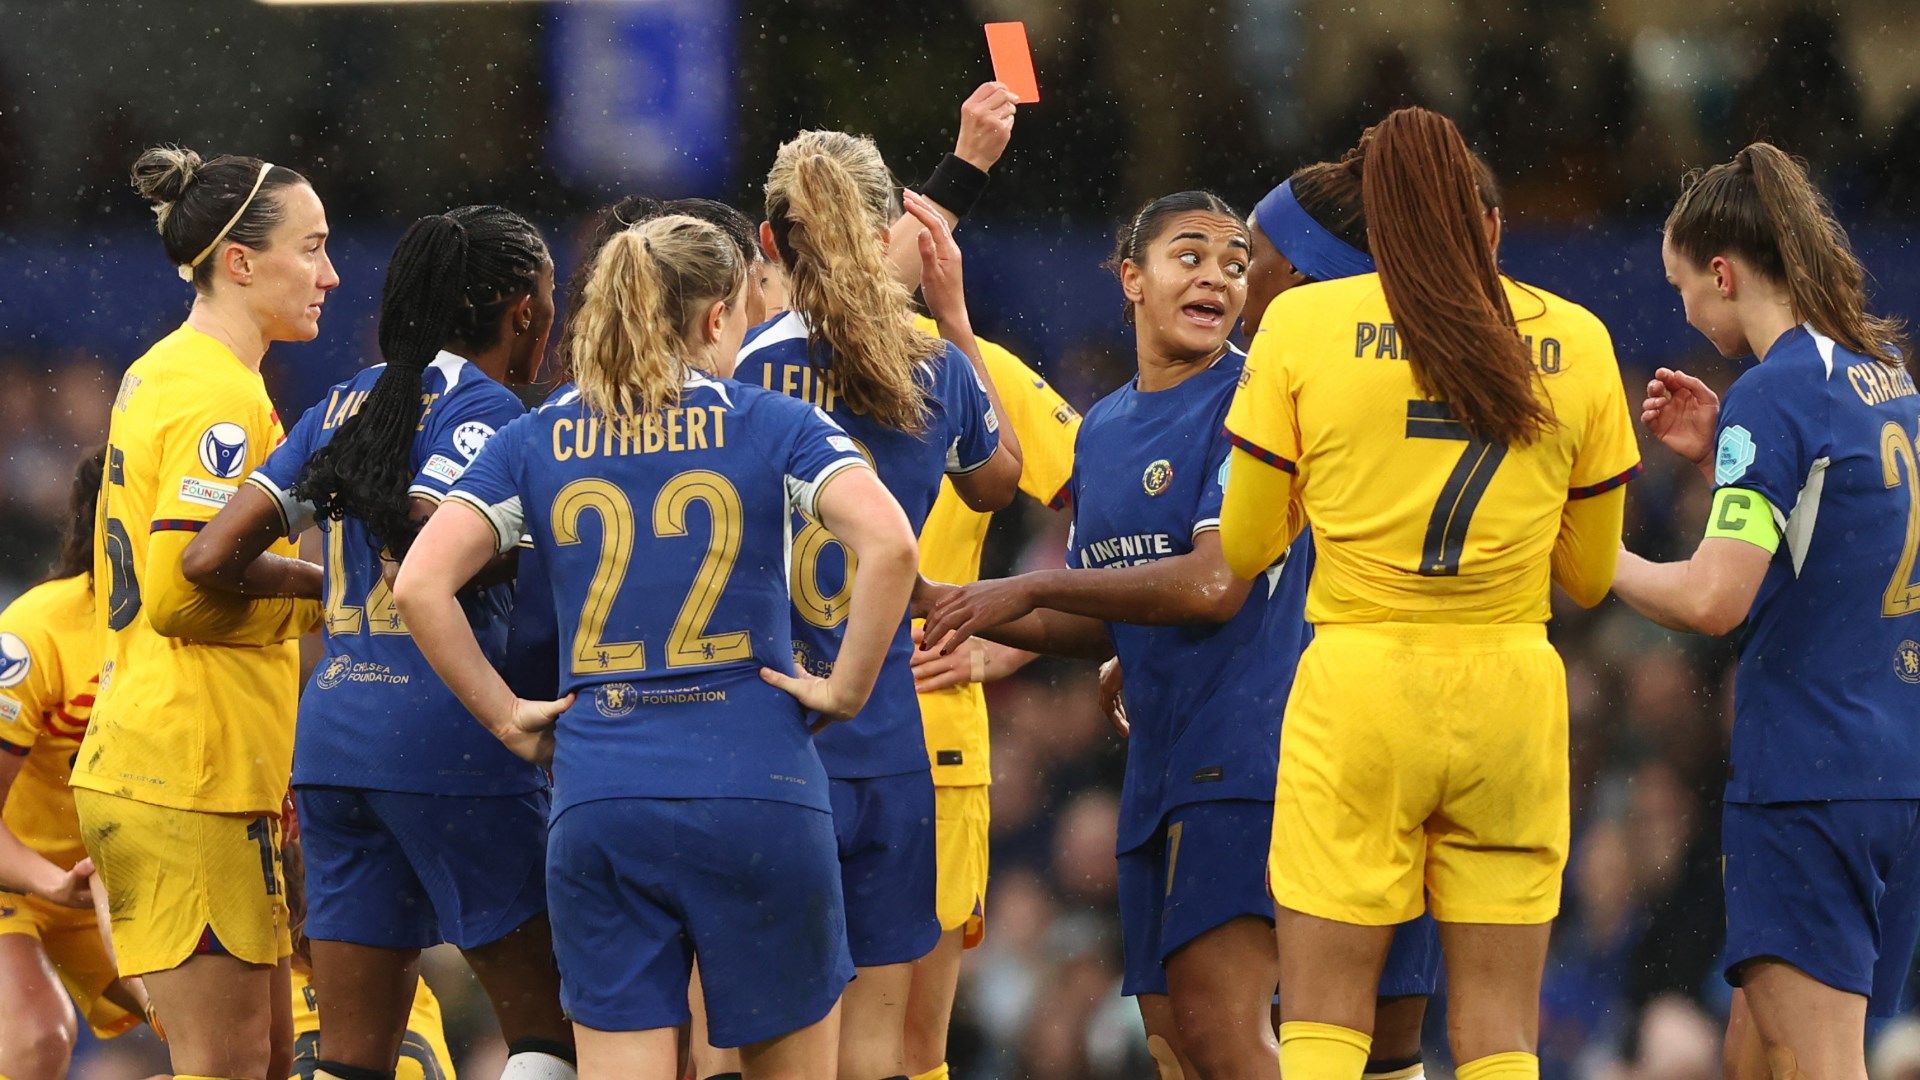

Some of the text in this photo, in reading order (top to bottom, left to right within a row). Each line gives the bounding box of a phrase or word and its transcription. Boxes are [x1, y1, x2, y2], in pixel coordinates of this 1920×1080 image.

[552, 405, 728, 462] CUTHBERT
[181, 484, 233, 502] FOUNDAT
[1405, 400, 1510, 576] 7
[1717, 495, 1750, 530] C
[1090, 533, 1172, 563] INFNITE
[551, 470, 753, 676] 22
[347, 673, 409, 684] FOUNDATION
[643, 691, 726, 704] FOUNDATION
